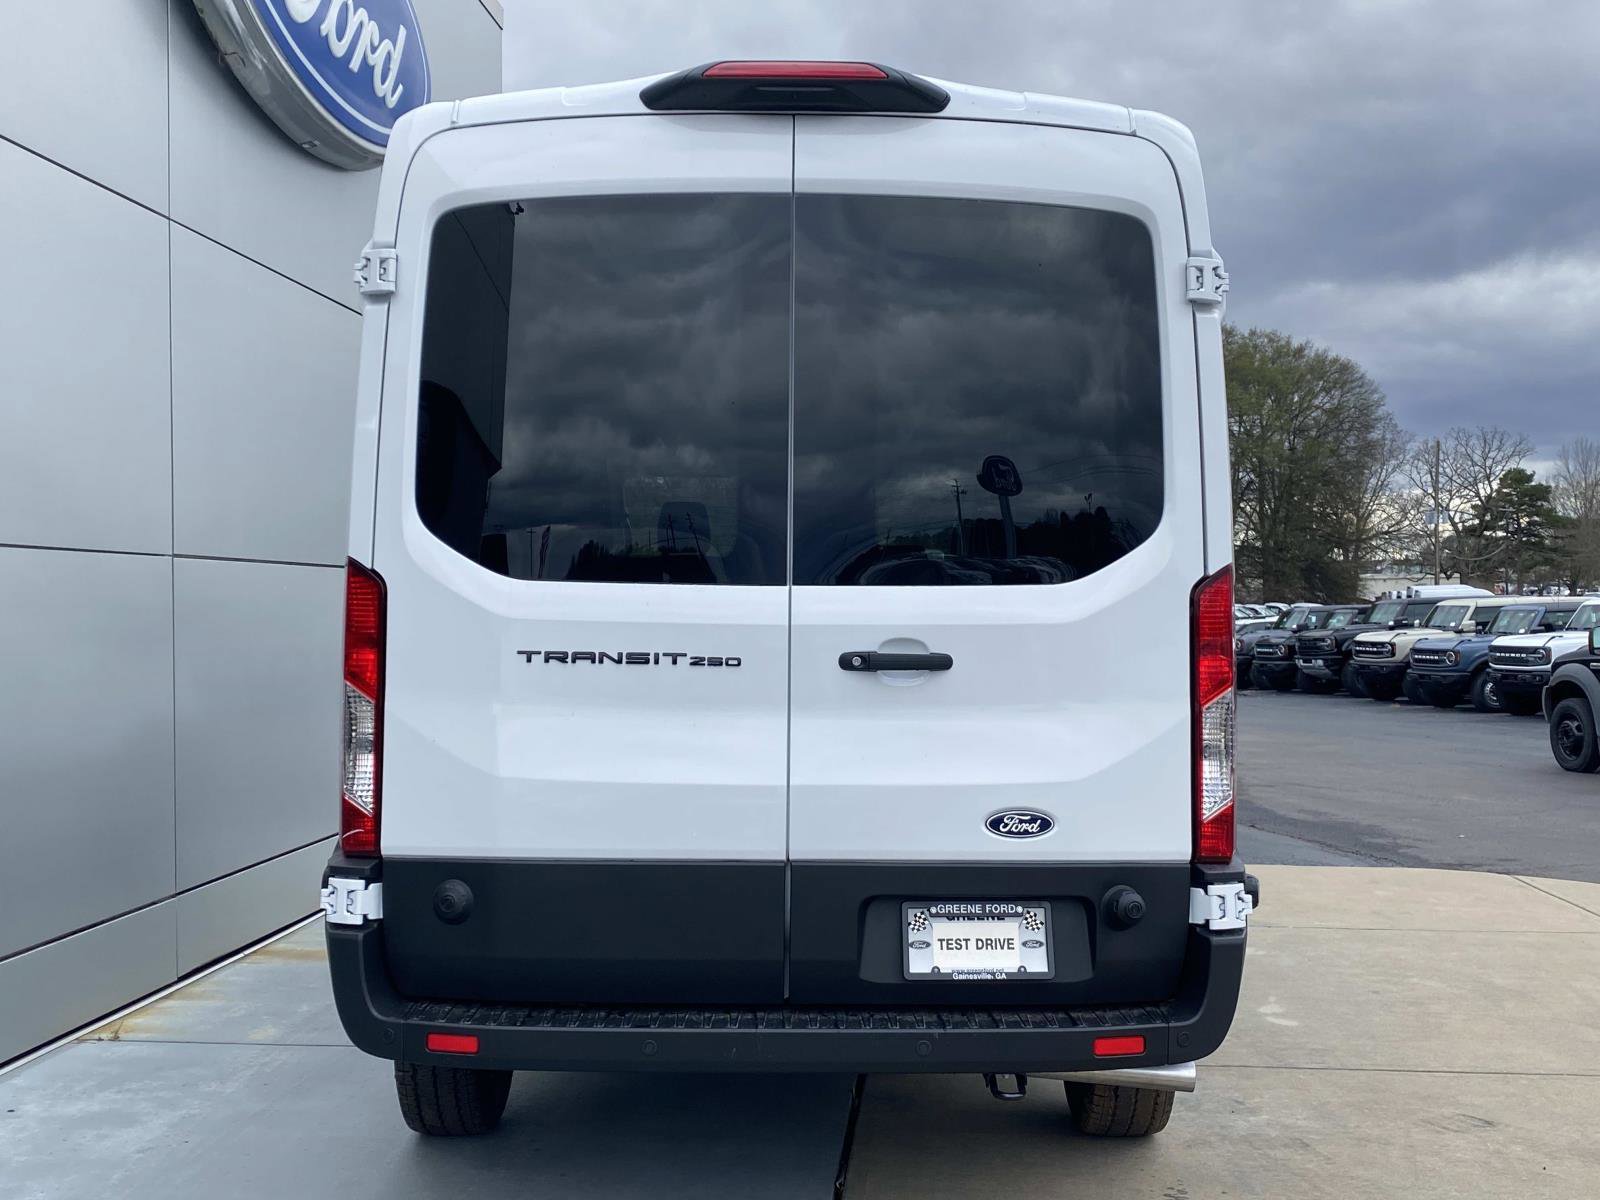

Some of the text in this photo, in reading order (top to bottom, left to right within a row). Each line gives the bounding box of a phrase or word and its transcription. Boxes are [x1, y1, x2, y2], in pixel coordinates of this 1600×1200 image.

[517, 650, 742, 667] TRANSIT 250
[1000, 815, 1042, 832] Ford
[937, 904, 1016, 914] GREENE FORD
[937, 938, 1015, 950] TEST DRIVE
[995, 972, 1007, 980] GA
